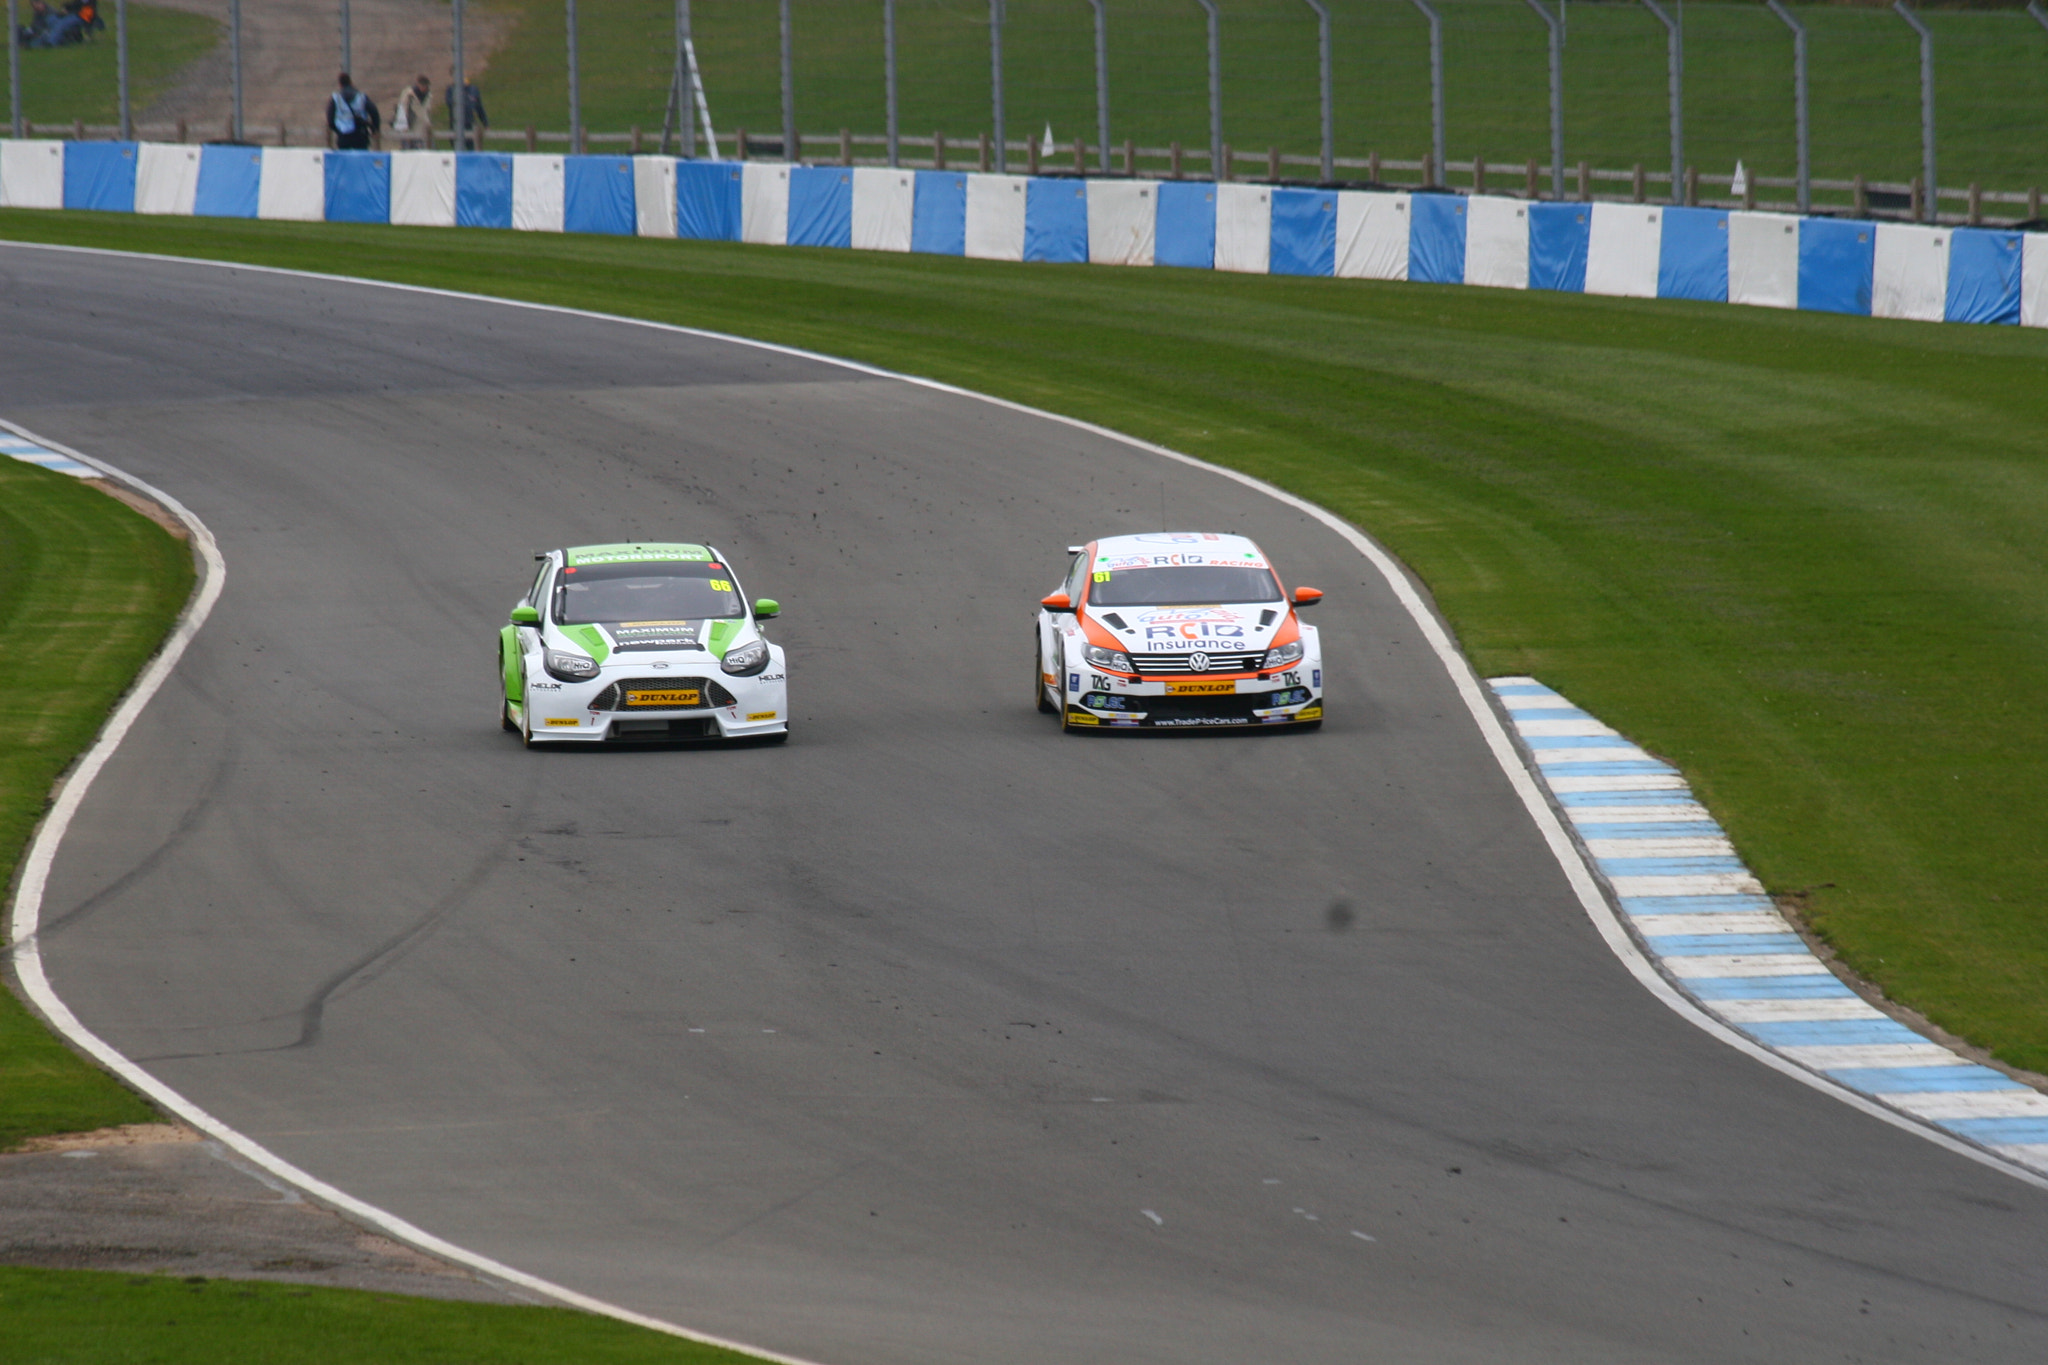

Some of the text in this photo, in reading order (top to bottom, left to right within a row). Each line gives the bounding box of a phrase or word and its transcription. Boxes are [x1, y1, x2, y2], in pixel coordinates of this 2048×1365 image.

[576, 554, 704, 564] MOTORSPORT
[1209, 560, 1264, 568] RACING
[1093, 571, 1112, 583] 61
[709, 579, 732, 592] 66
[615, 627, 695, 635] MAXIMUM
[1091, 674, 1111, 691] TAG
[1177, 684, 1235, 693] DUNLOP
[639, 693, 698, 702] DUNLOP
